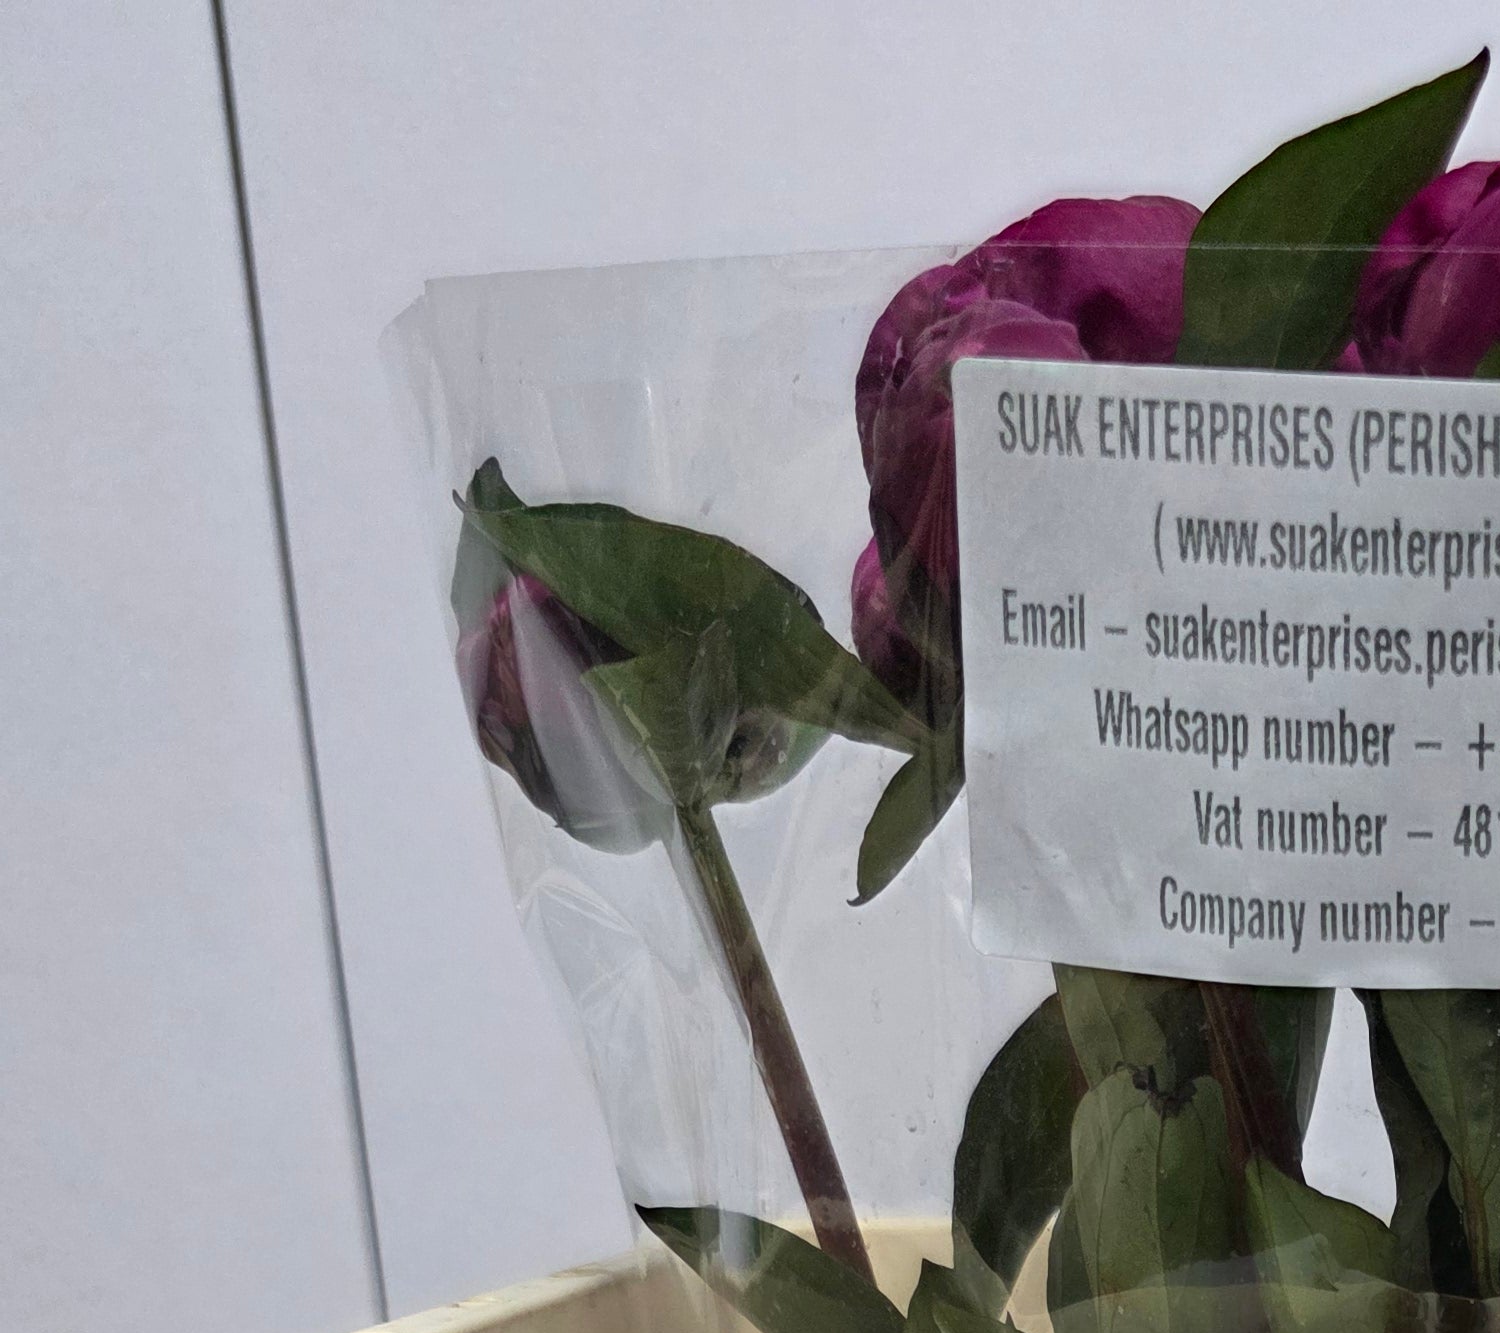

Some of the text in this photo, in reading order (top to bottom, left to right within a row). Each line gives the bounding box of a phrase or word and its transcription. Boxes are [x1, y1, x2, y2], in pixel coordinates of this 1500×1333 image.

[998, 391, 1083, 457] SUAK
[1099, 396, 1334, 470] ENTERPRISES
[1001, 588, 1086, 652] Email
[1094, 687, 1249, 771] Whatsapp
[1263, 707, 1396, 767] number
[1193, 789, 1243, 850] Vat
[1256, 800, 1388, 857] number
[1159, 875, 1306, 954] Company
[1320, 891, 1450, 943] number
